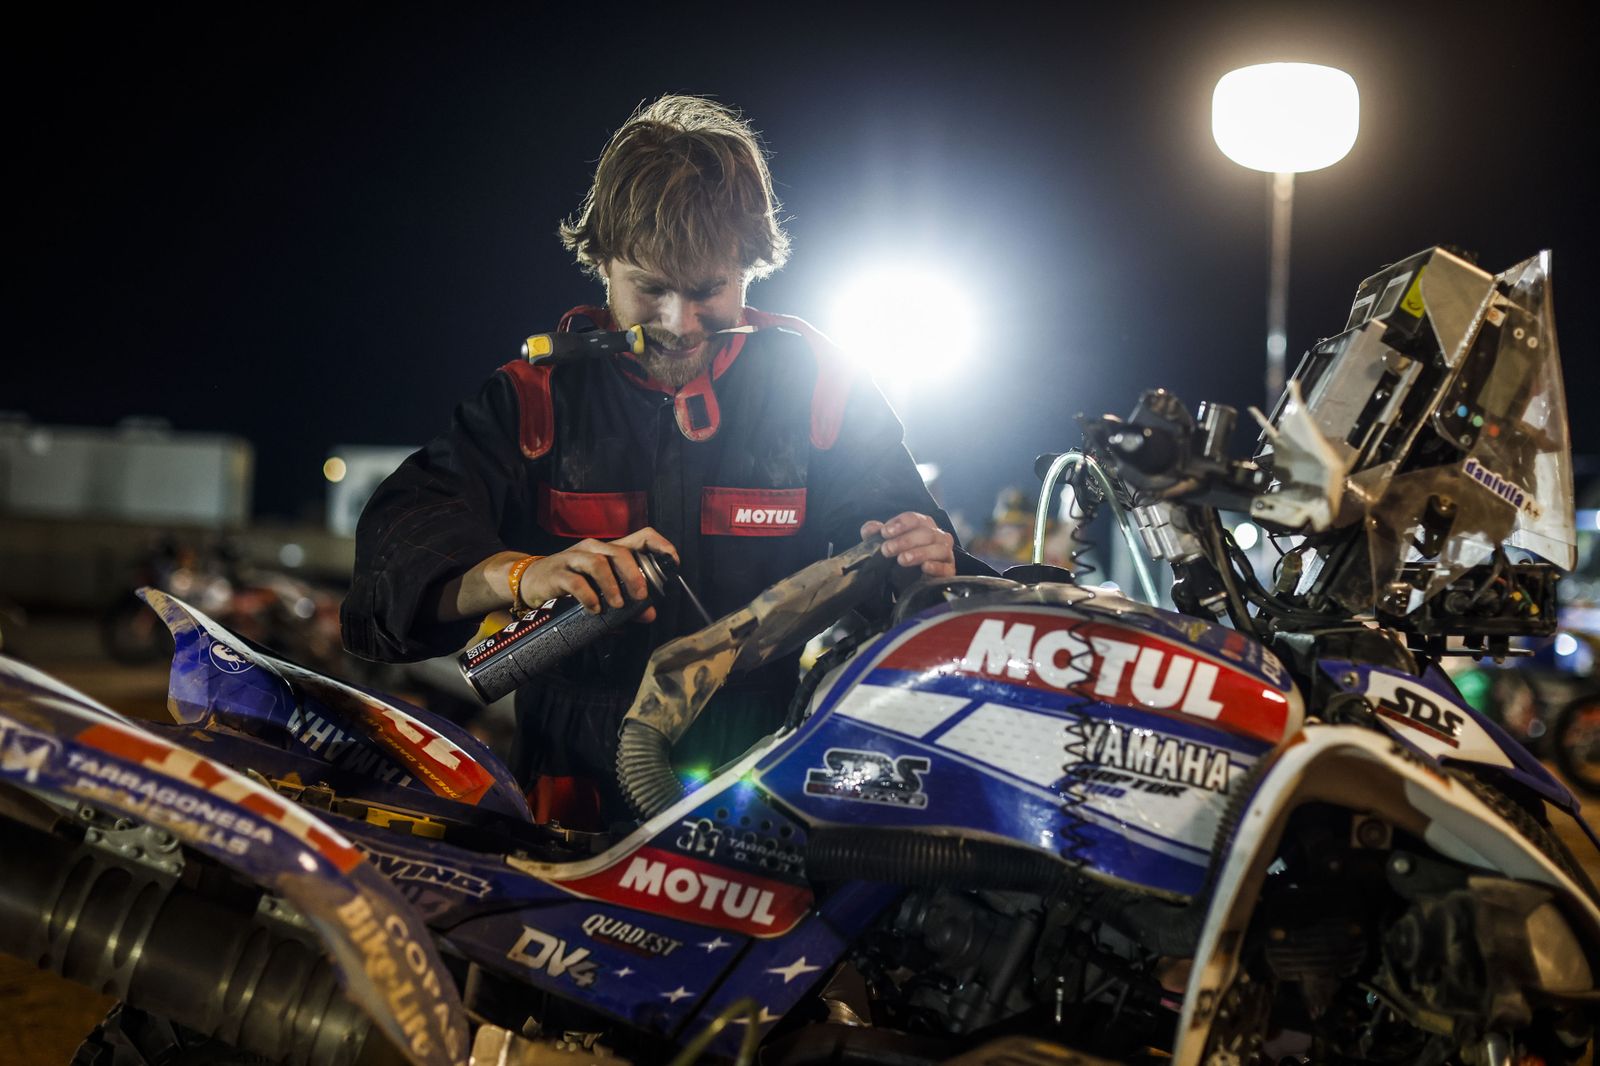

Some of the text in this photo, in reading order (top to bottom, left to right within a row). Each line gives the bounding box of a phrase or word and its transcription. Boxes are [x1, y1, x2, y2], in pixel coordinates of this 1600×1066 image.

[735, 508, 798, 525] MOTUL
[960, 618, 1225, 721] MOTUL
[1080, 721, 1231, 795] YAMAHA
[618, 856, 776, 926] MOTUL
[506, 924, 601, 987] DV4
[582, 913, 683, 957] QUADEST
